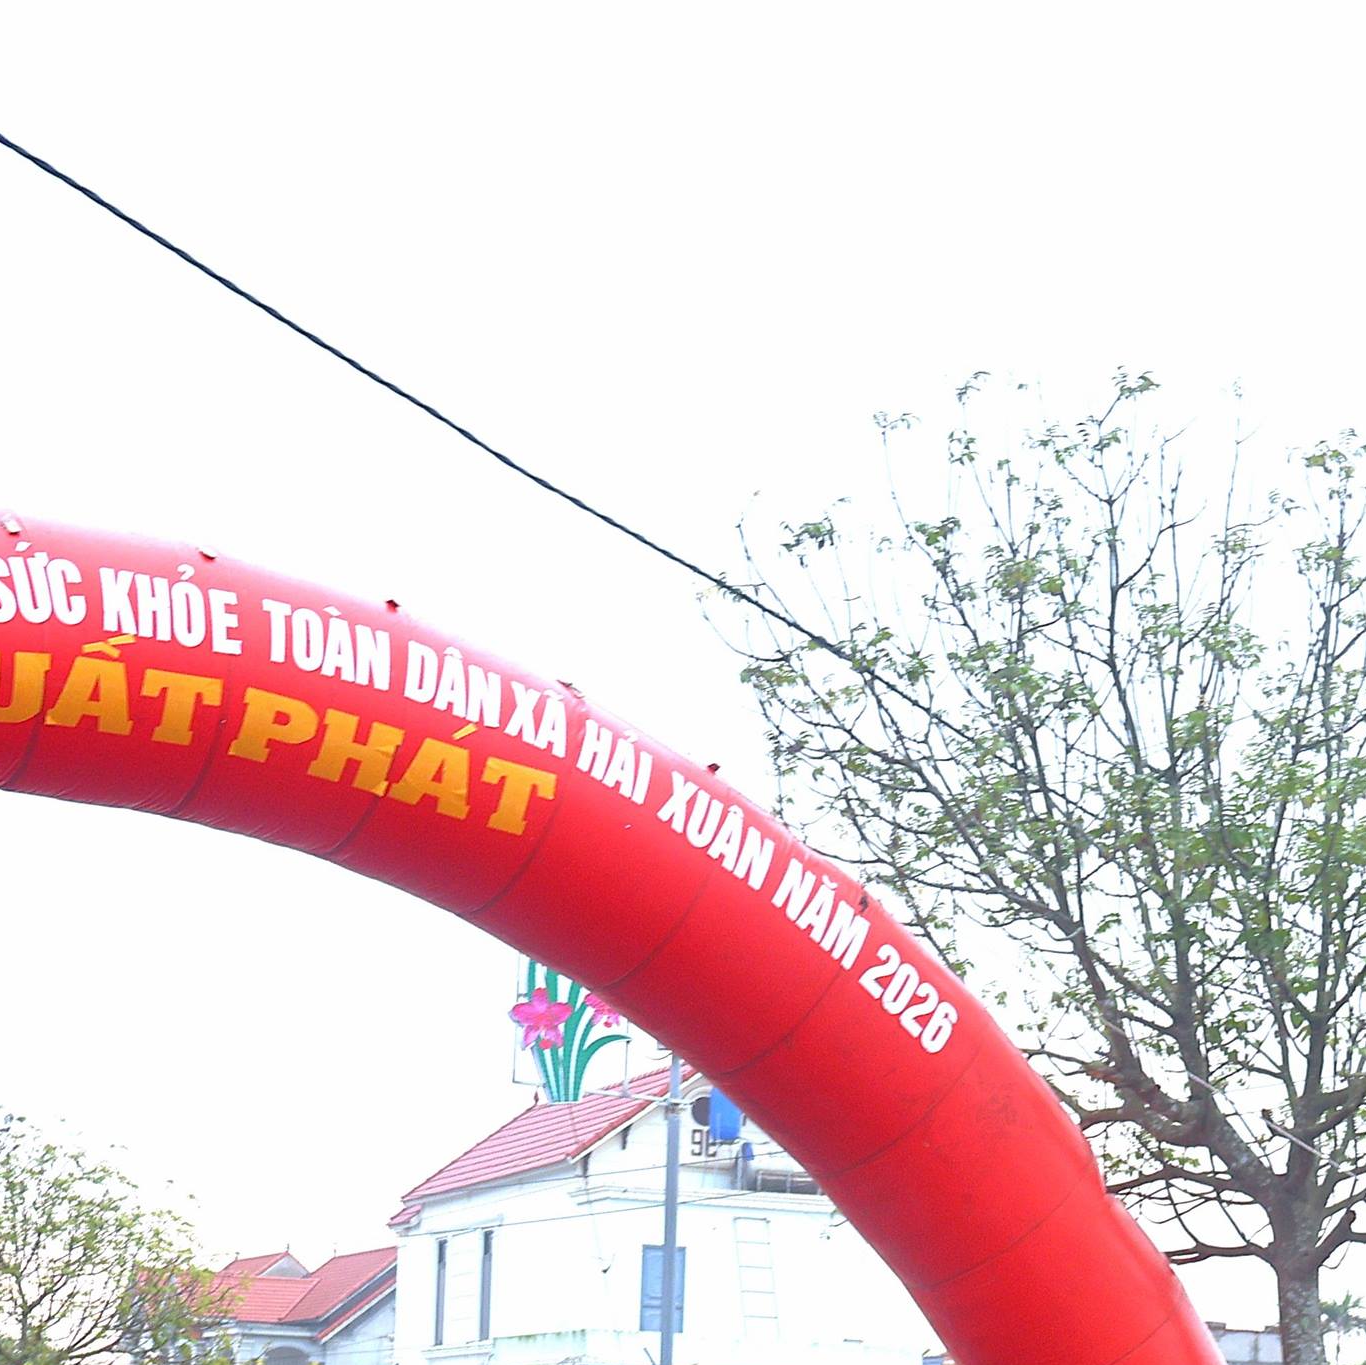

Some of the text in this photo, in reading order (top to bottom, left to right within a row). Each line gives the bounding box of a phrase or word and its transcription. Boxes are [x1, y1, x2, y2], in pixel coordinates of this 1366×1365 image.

[100, 564, 243, 655] KHỎE
[262, 599, 390, 691] TOÀN
[404, 641, 501, 729] DÂN
[504, 680, 567, 758] XÃ
[576, 718, 653, 805] HẢI
[657, 770, 775, 891] XUÂN
[771, 858, 870, 970] NĂM
[858, 944, 960, 1054] 2026
[229, 690, 557, 835] PHÁT
